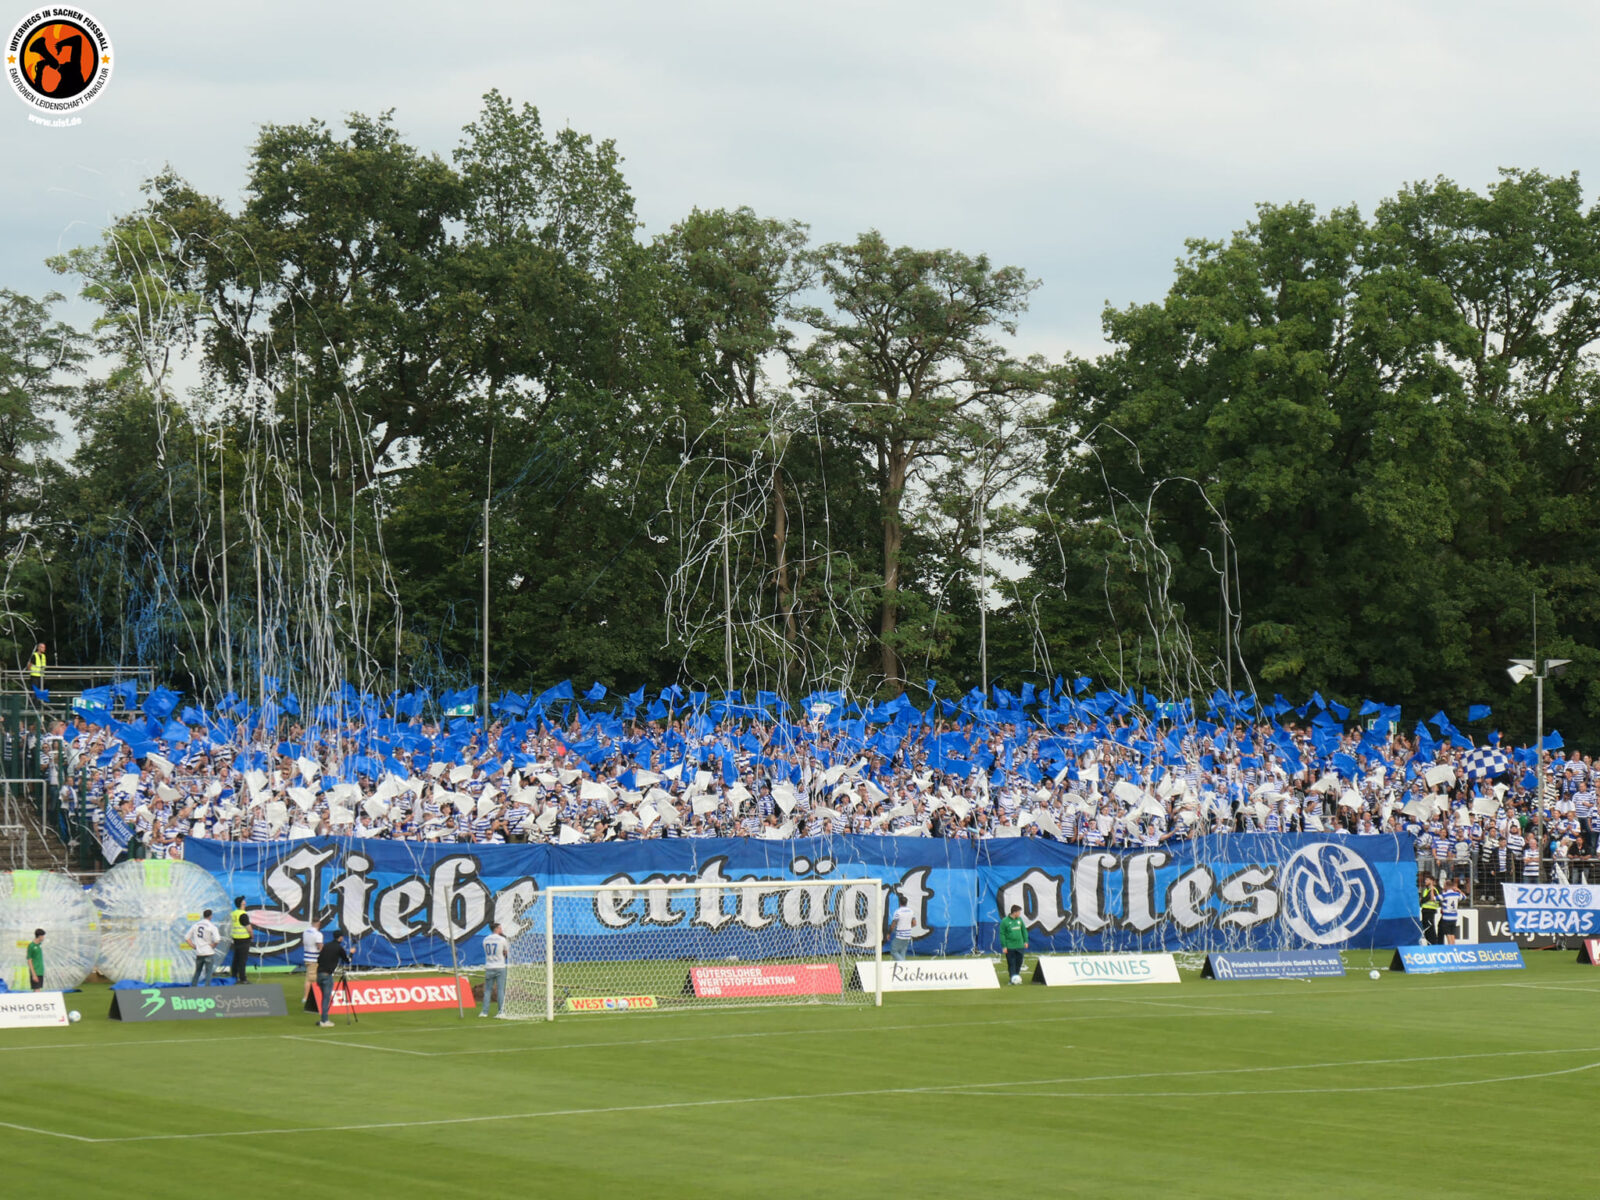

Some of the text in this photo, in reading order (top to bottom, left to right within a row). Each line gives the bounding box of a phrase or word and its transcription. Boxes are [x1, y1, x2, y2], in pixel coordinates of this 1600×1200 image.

[244, 845, 1283, 954] Liebe erträgt alles
[1514, 911, 1595, 932] ZEBRAS
[1414, 948, 1519, 965] euronics Bücker
[890, 962, 969, 982] Rickmann
[1068, 958, 1151, 976] TÖNNIES
[698, 976, 796, 987] WERTSTOFFZENTRUM
[331, 984, 457, 1006] HAGEDORN
[571, 998, 604, 1009] WEST
[0, 1002, 56, 1013] NNHORST
